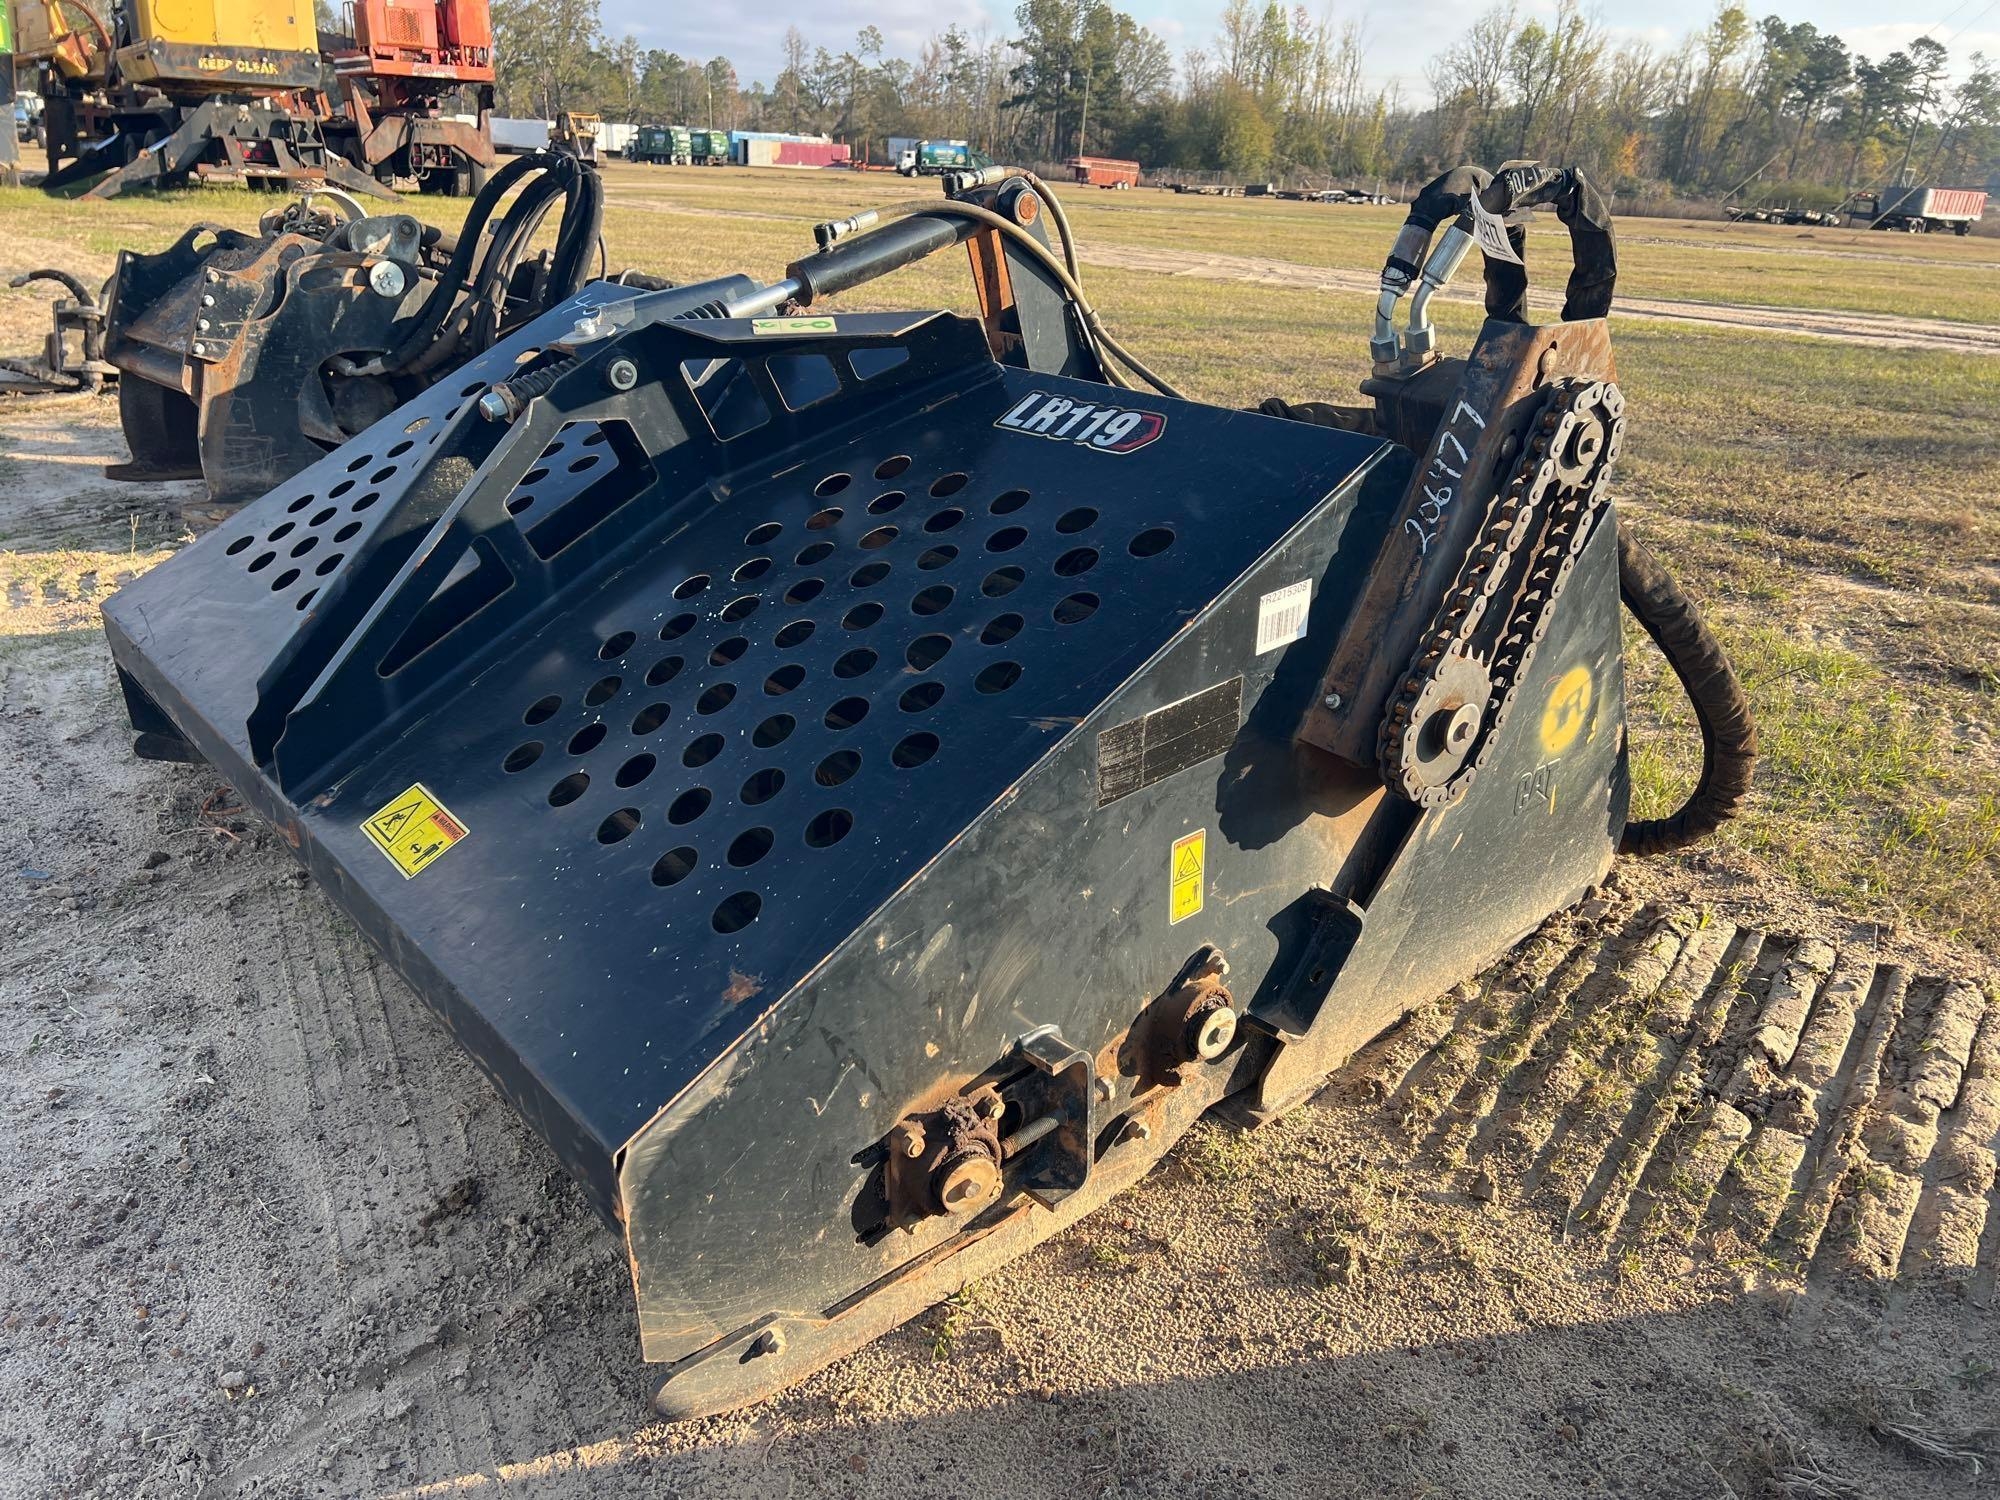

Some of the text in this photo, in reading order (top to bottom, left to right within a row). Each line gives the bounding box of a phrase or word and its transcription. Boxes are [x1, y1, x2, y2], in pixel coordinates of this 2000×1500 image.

[198, 57, 279, 75] KEEP CLEAR
[1000, 392, 1142, 447] LR119
